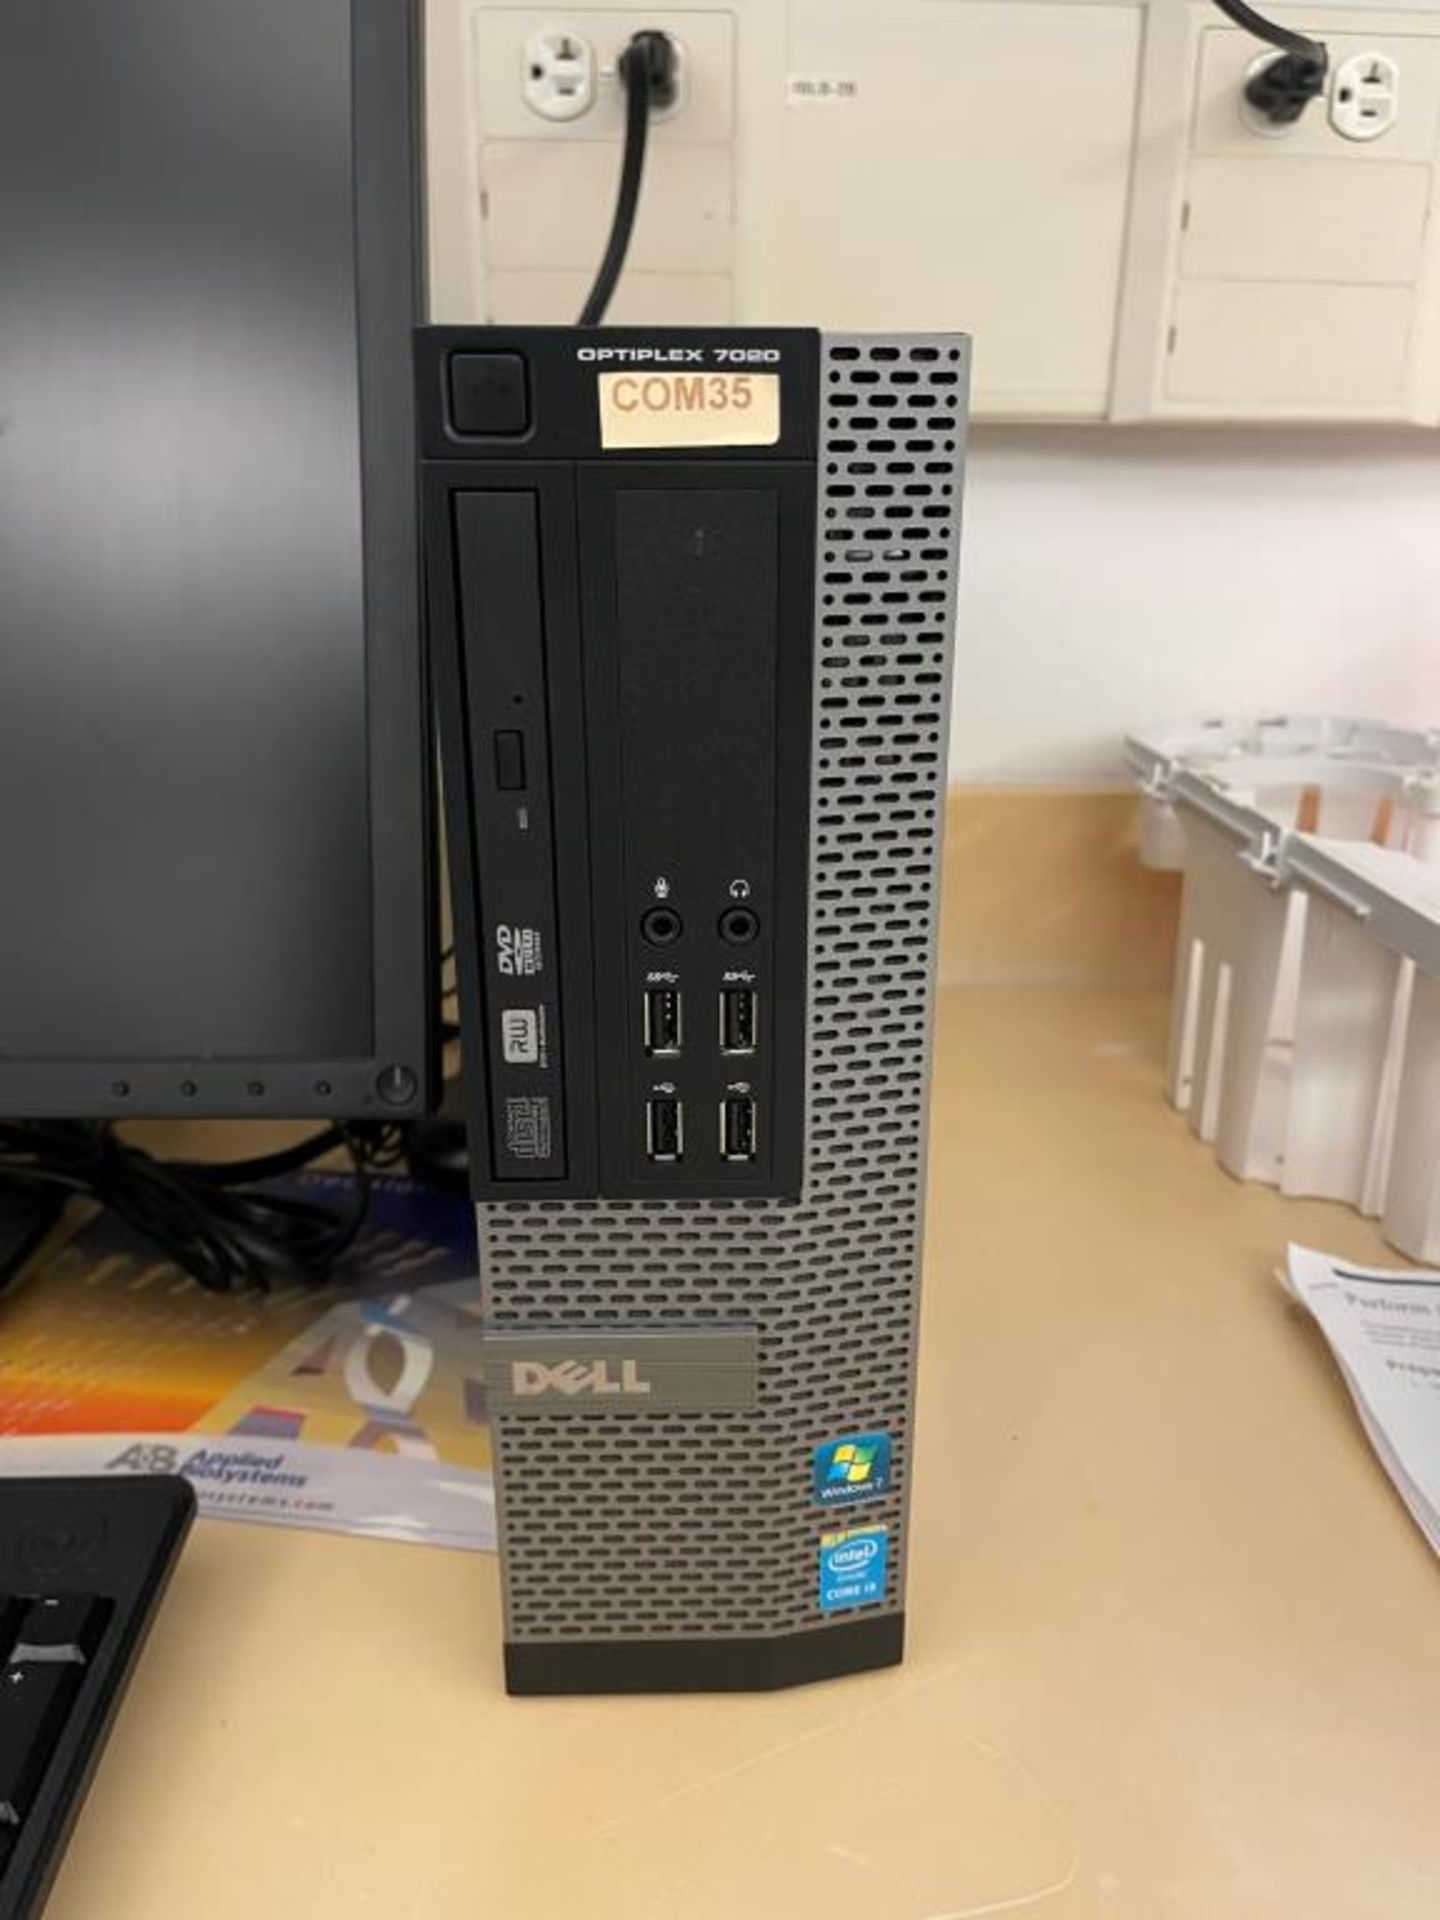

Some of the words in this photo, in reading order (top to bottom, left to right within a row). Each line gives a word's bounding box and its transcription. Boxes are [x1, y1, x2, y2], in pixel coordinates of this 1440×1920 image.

[577, 349, 702, 362] OPTIPLEX
[714, 349, 781, 362] 7020
[612, 377, 753, 412] COM35
[496, 924, 514, 976] DVD
[511, 1360, 651, 1395] DELL
[191, 1449, 283, 1470] Applied
[820, 1482, 873, 1498] Windows
